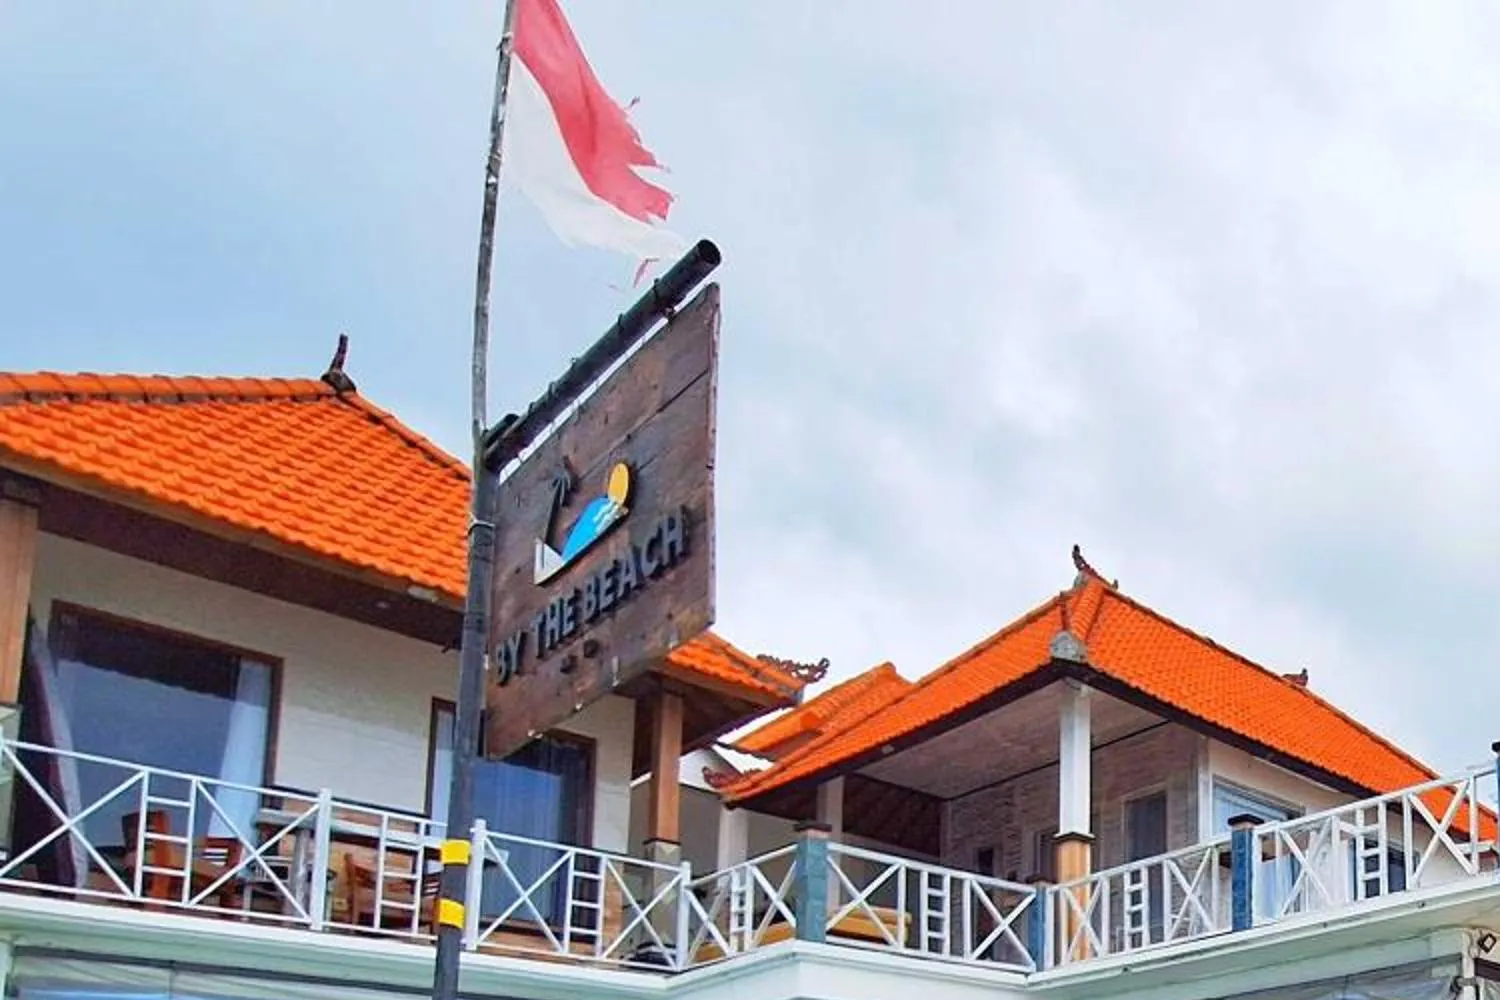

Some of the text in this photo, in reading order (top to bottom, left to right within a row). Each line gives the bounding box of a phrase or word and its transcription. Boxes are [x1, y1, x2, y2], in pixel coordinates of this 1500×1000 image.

[496, 507, 688, 684] BY THE BEACH
